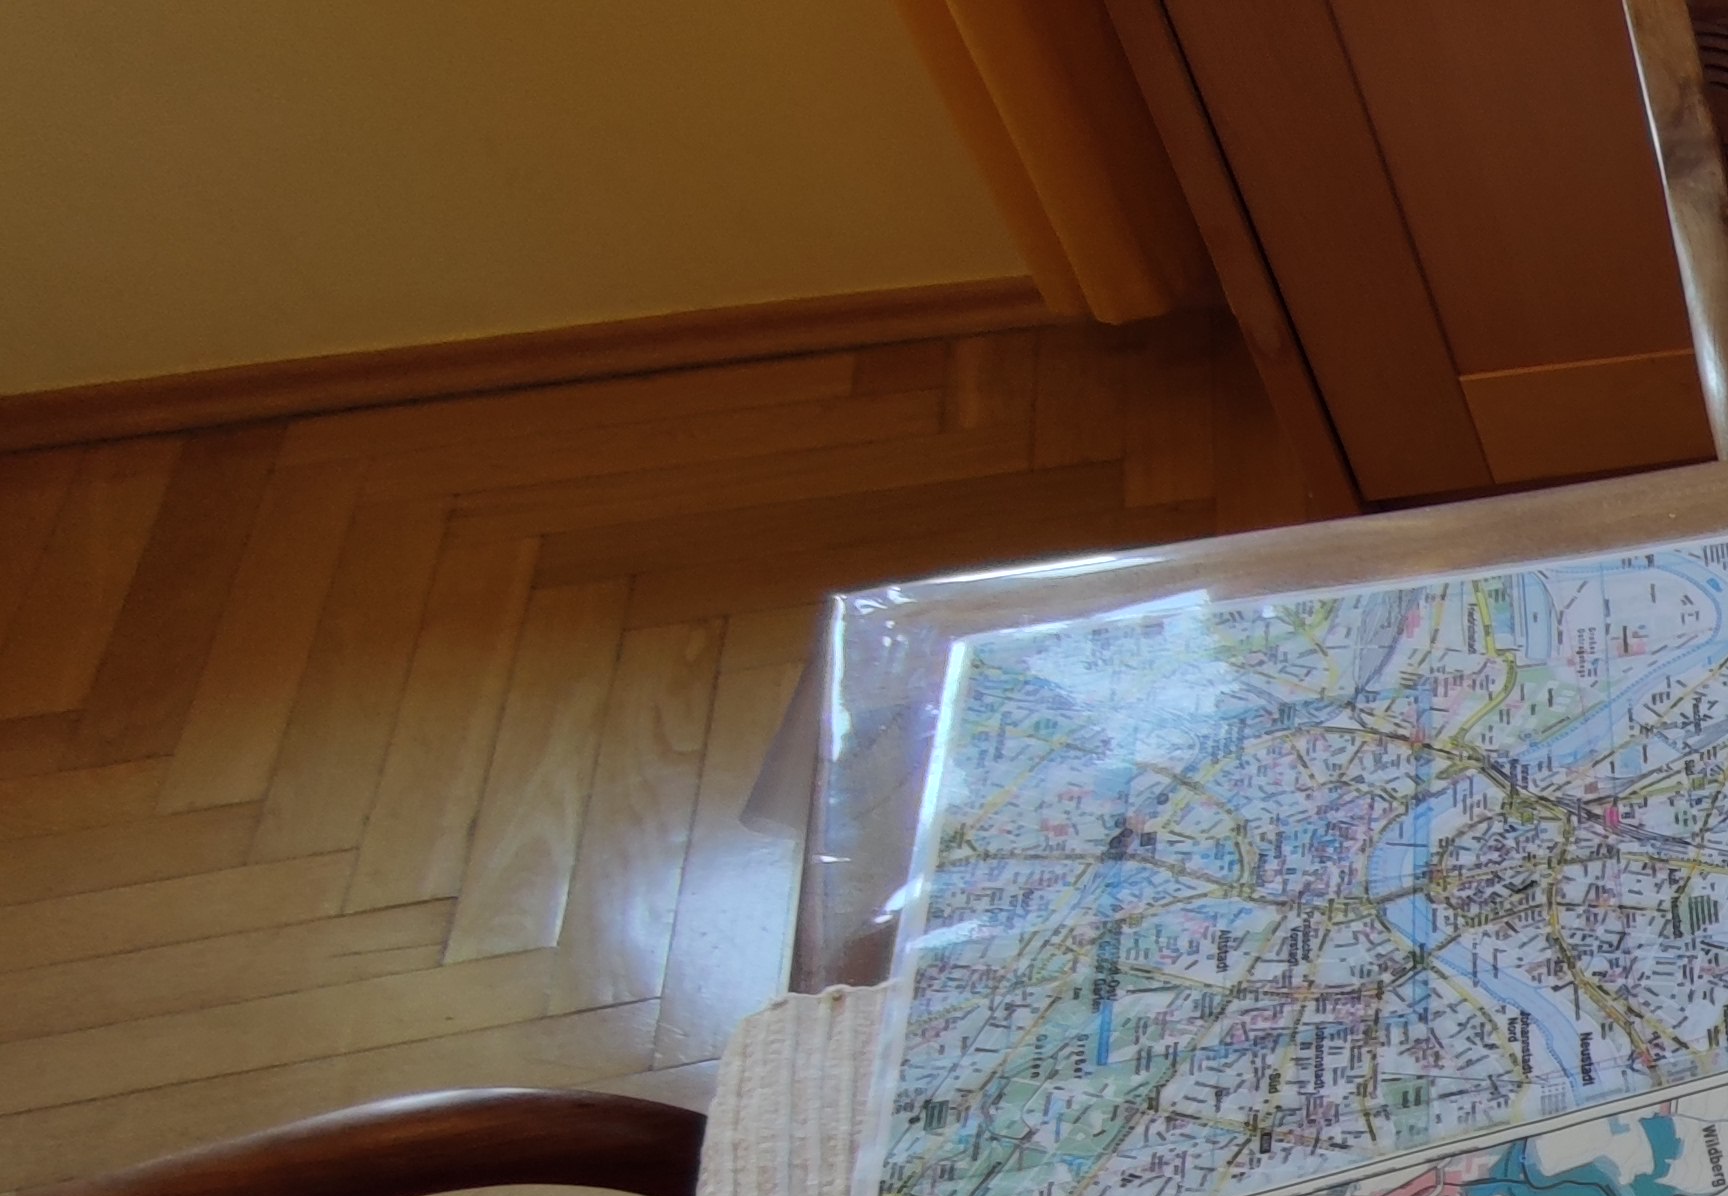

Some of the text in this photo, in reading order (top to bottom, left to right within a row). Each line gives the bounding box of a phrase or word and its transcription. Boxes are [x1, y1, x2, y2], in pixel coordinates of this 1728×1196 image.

[1215, 928, 1231, 973] Altstadt
[1506, 1016, 1520, 1042] Nord
[1579, 1031, 1597, 1087] Neustadt
